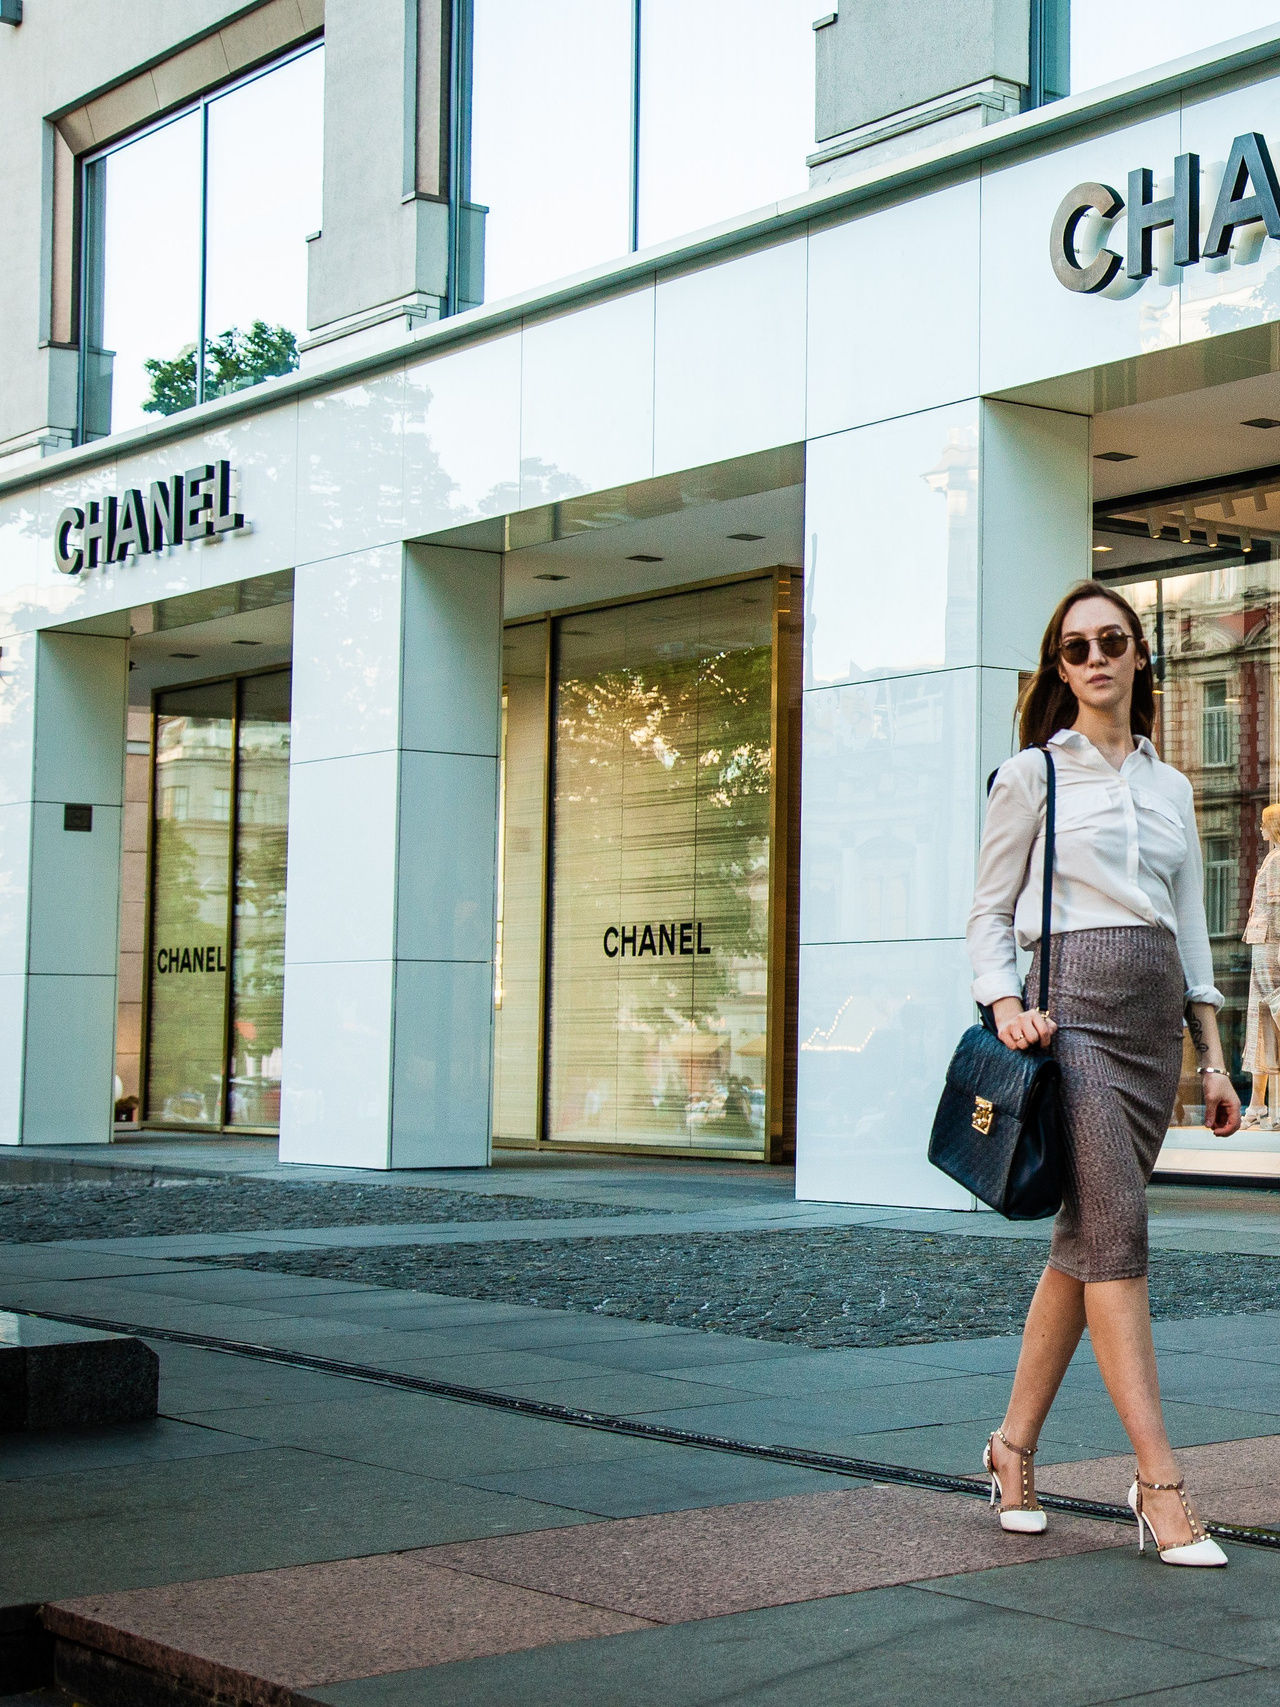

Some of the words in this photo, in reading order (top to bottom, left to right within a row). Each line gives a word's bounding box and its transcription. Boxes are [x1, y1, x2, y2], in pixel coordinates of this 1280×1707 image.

[55, 460, 245, 574] CHANEL
[603, 922, 711, 957] CHANEL
[157, 947, 226, 973] CHANEL
